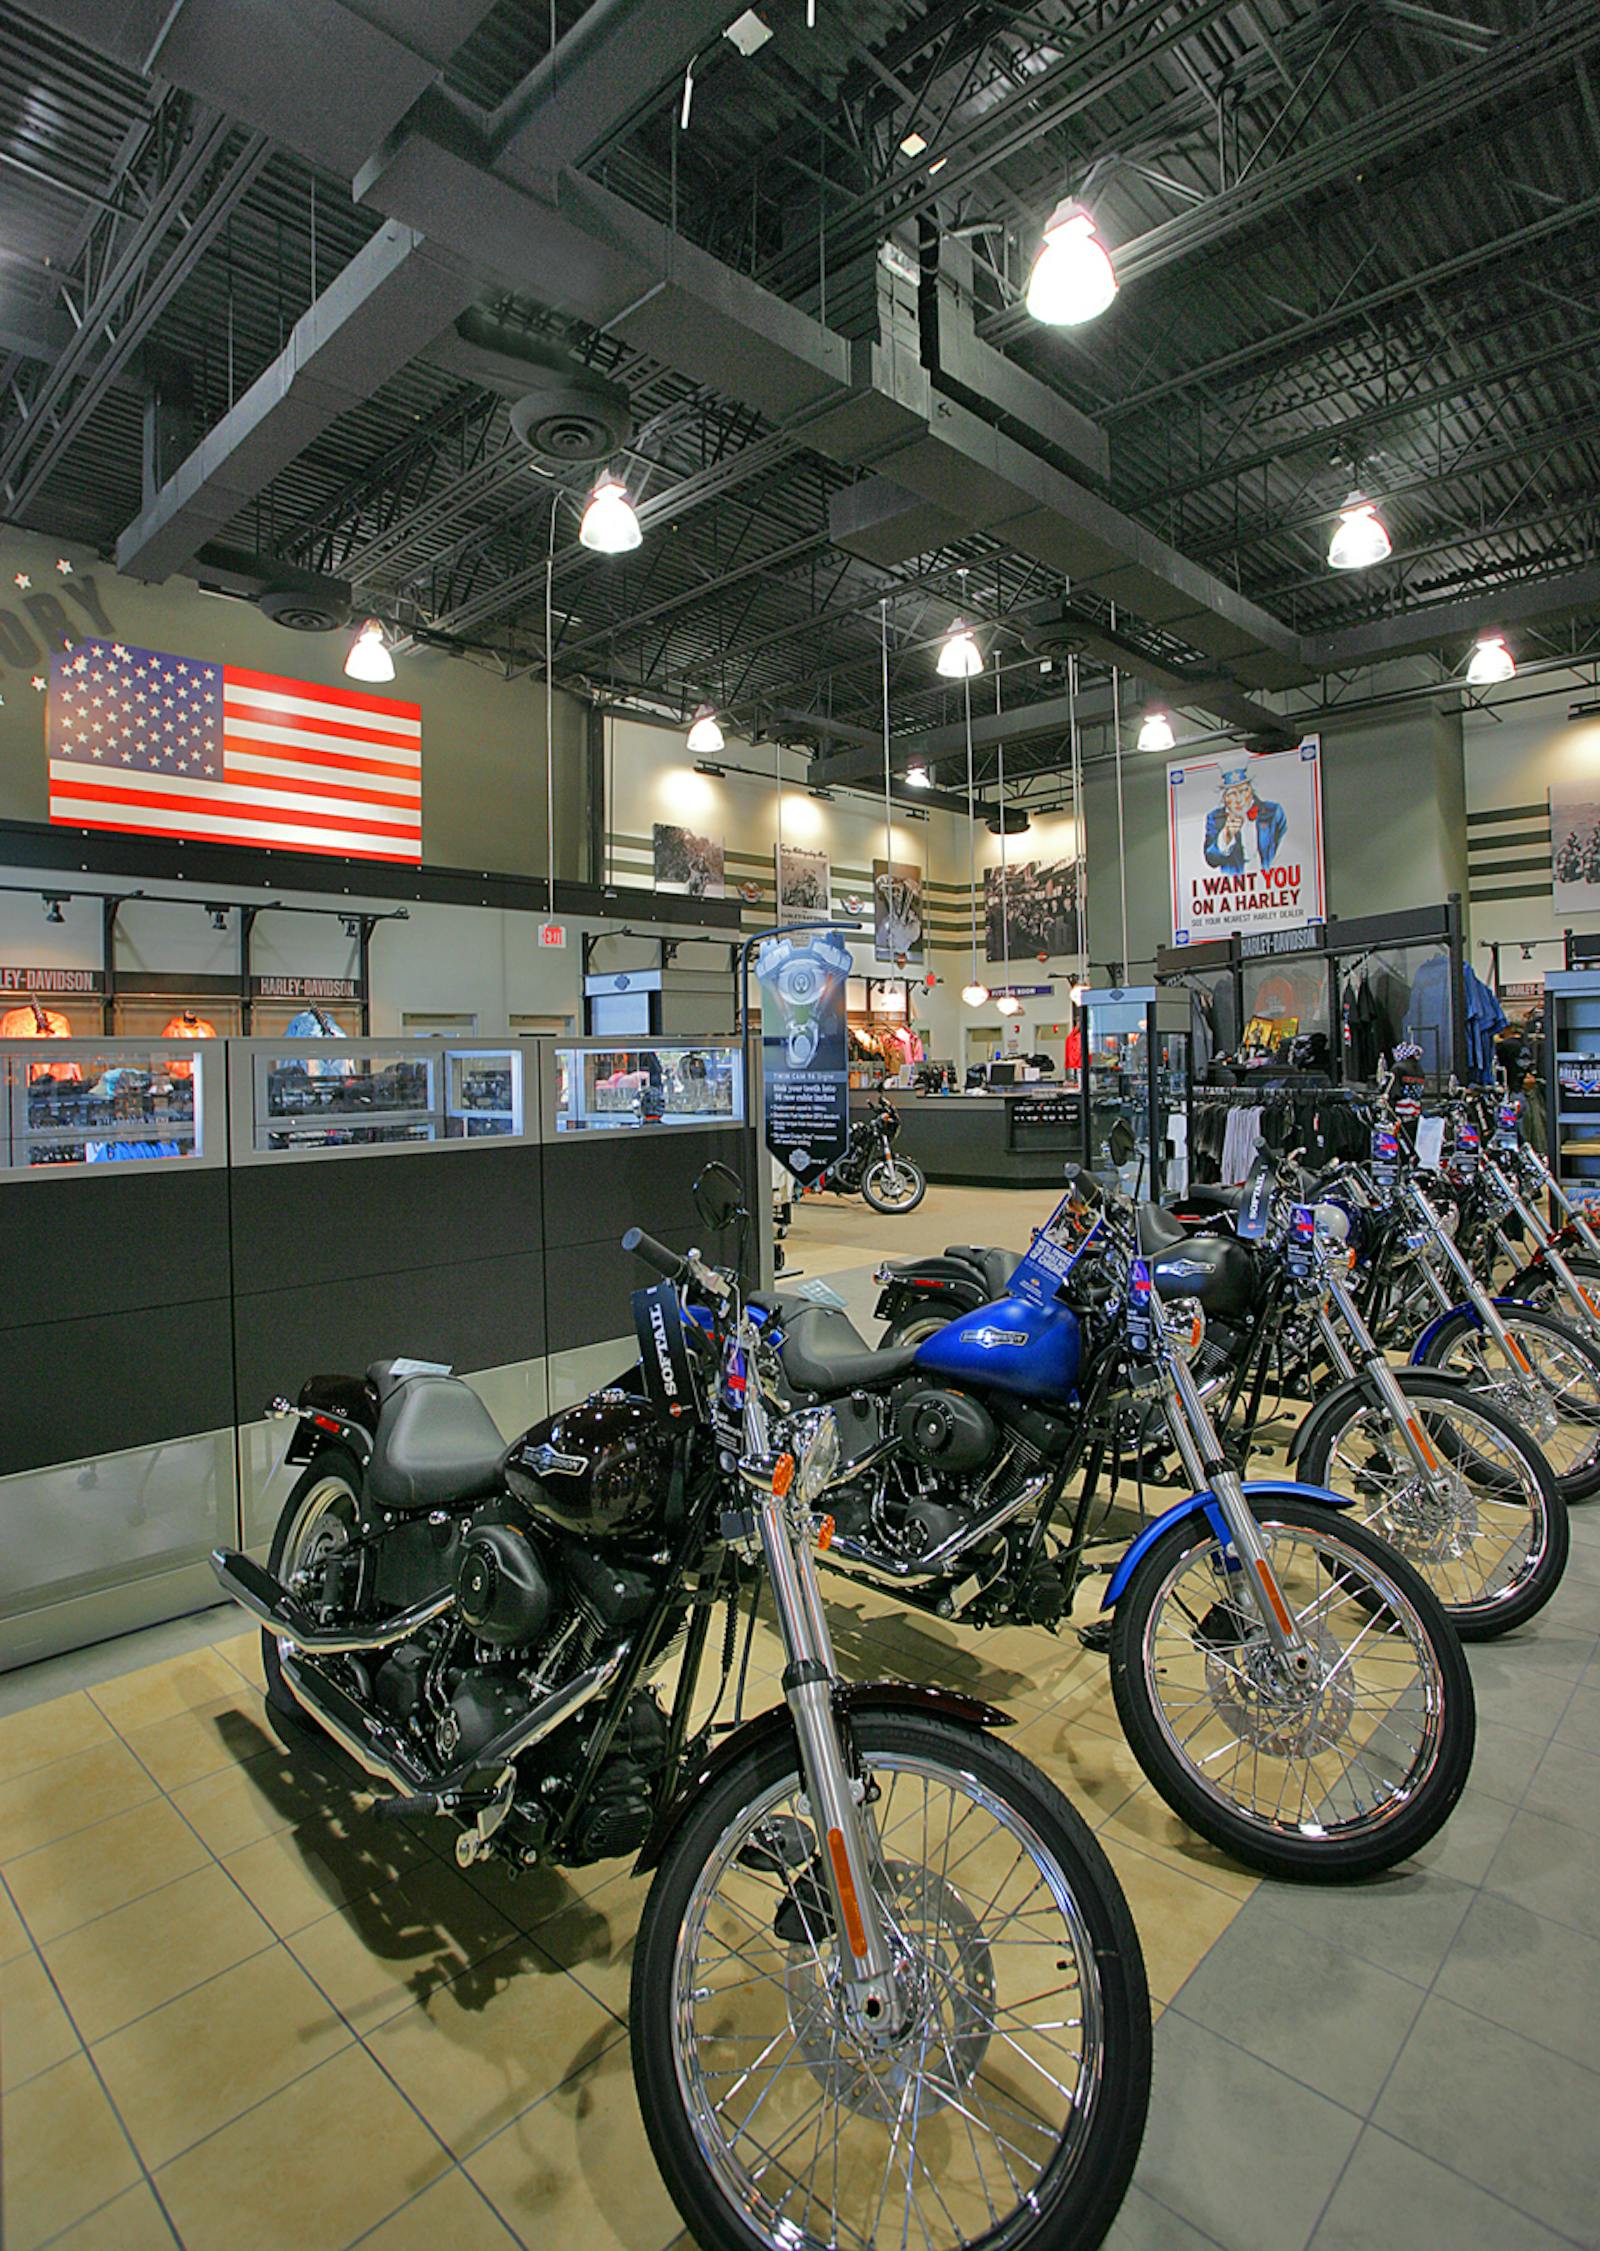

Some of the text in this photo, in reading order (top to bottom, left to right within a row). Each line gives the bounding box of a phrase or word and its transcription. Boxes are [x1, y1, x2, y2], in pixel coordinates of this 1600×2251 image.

[1192, 864, 1301, 897] I WANT YOU
[1192, 889, 1300, 915] ON A HARLEY
[1204, 917, 1221, 926] YOUR
[1224, 914, 1251, 924] NEAREST
[1253, 911, 1277, 921] HARLEY
[1280, 909, 1304, 919] DEALER
[261, 977, 355, 996] HARLEY-DAVIDSON
[649, 1303, 678, 1397] SOFTAIL
